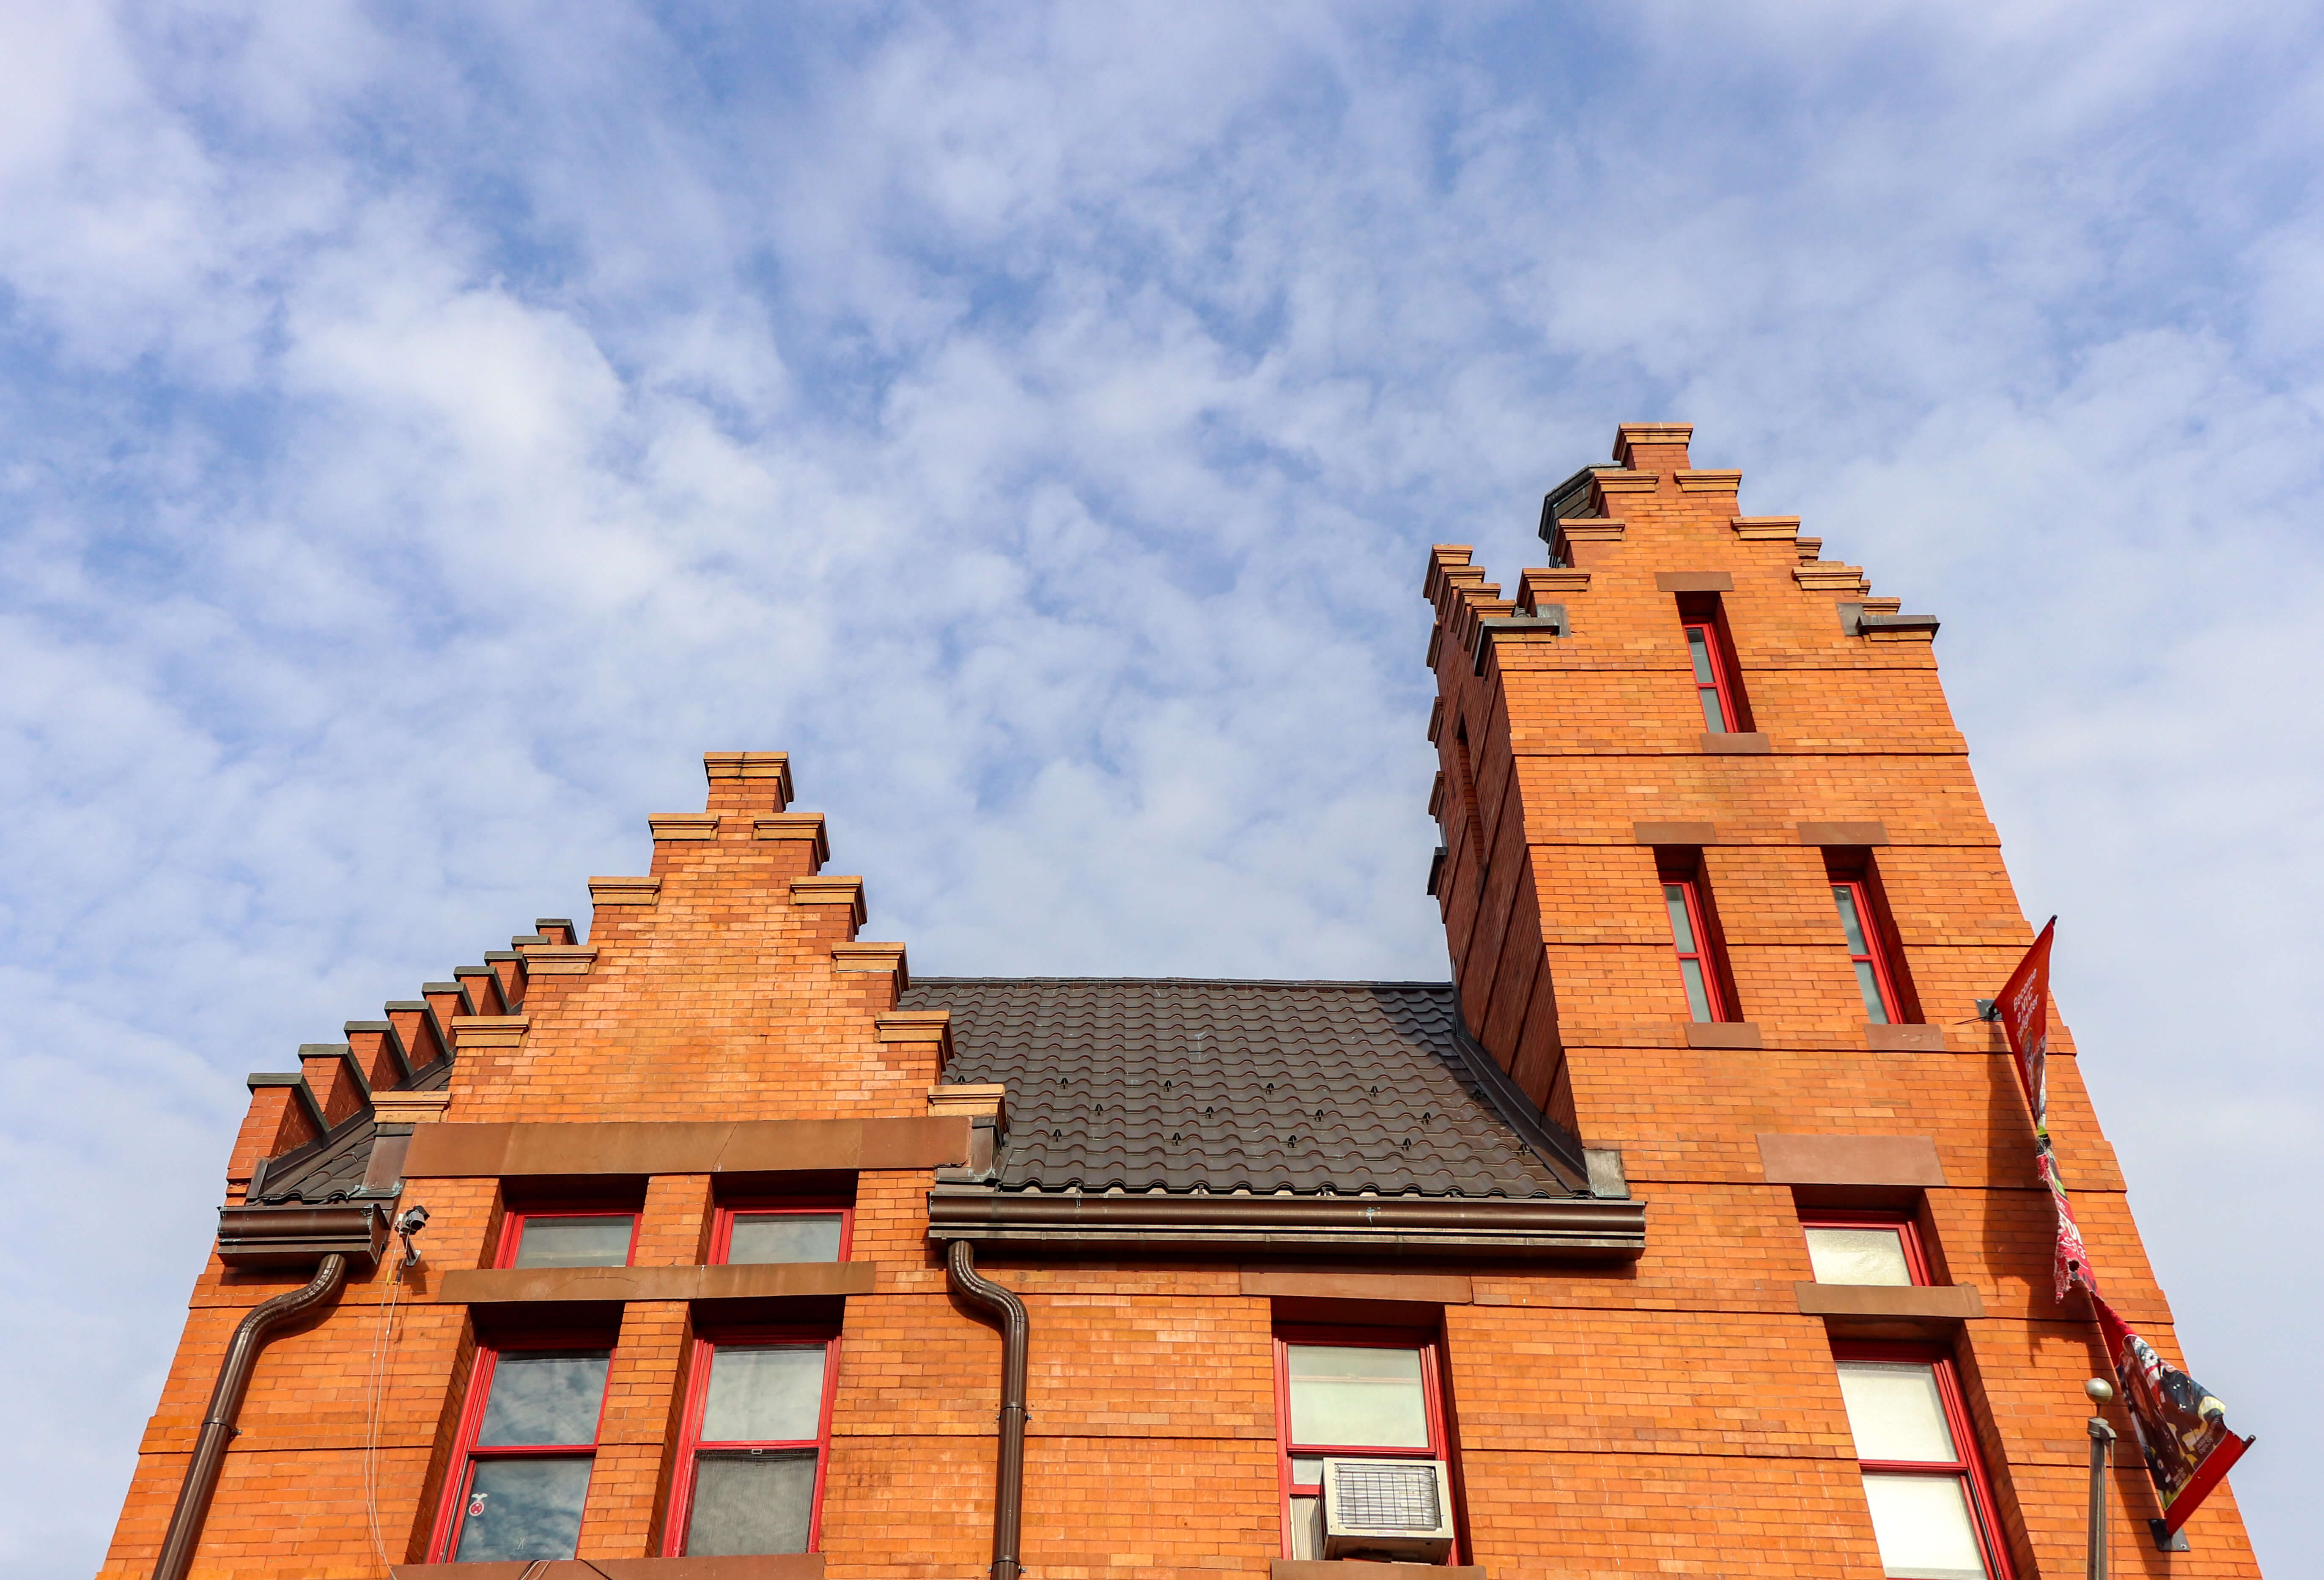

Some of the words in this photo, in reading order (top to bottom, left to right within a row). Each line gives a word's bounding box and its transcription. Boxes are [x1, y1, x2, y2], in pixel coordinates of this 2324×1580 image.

[2013, 968, 2037, 1012] Become
[2017, 1011, 2022, 1023] a
[2021, 986, 2033, 1015] NYC
